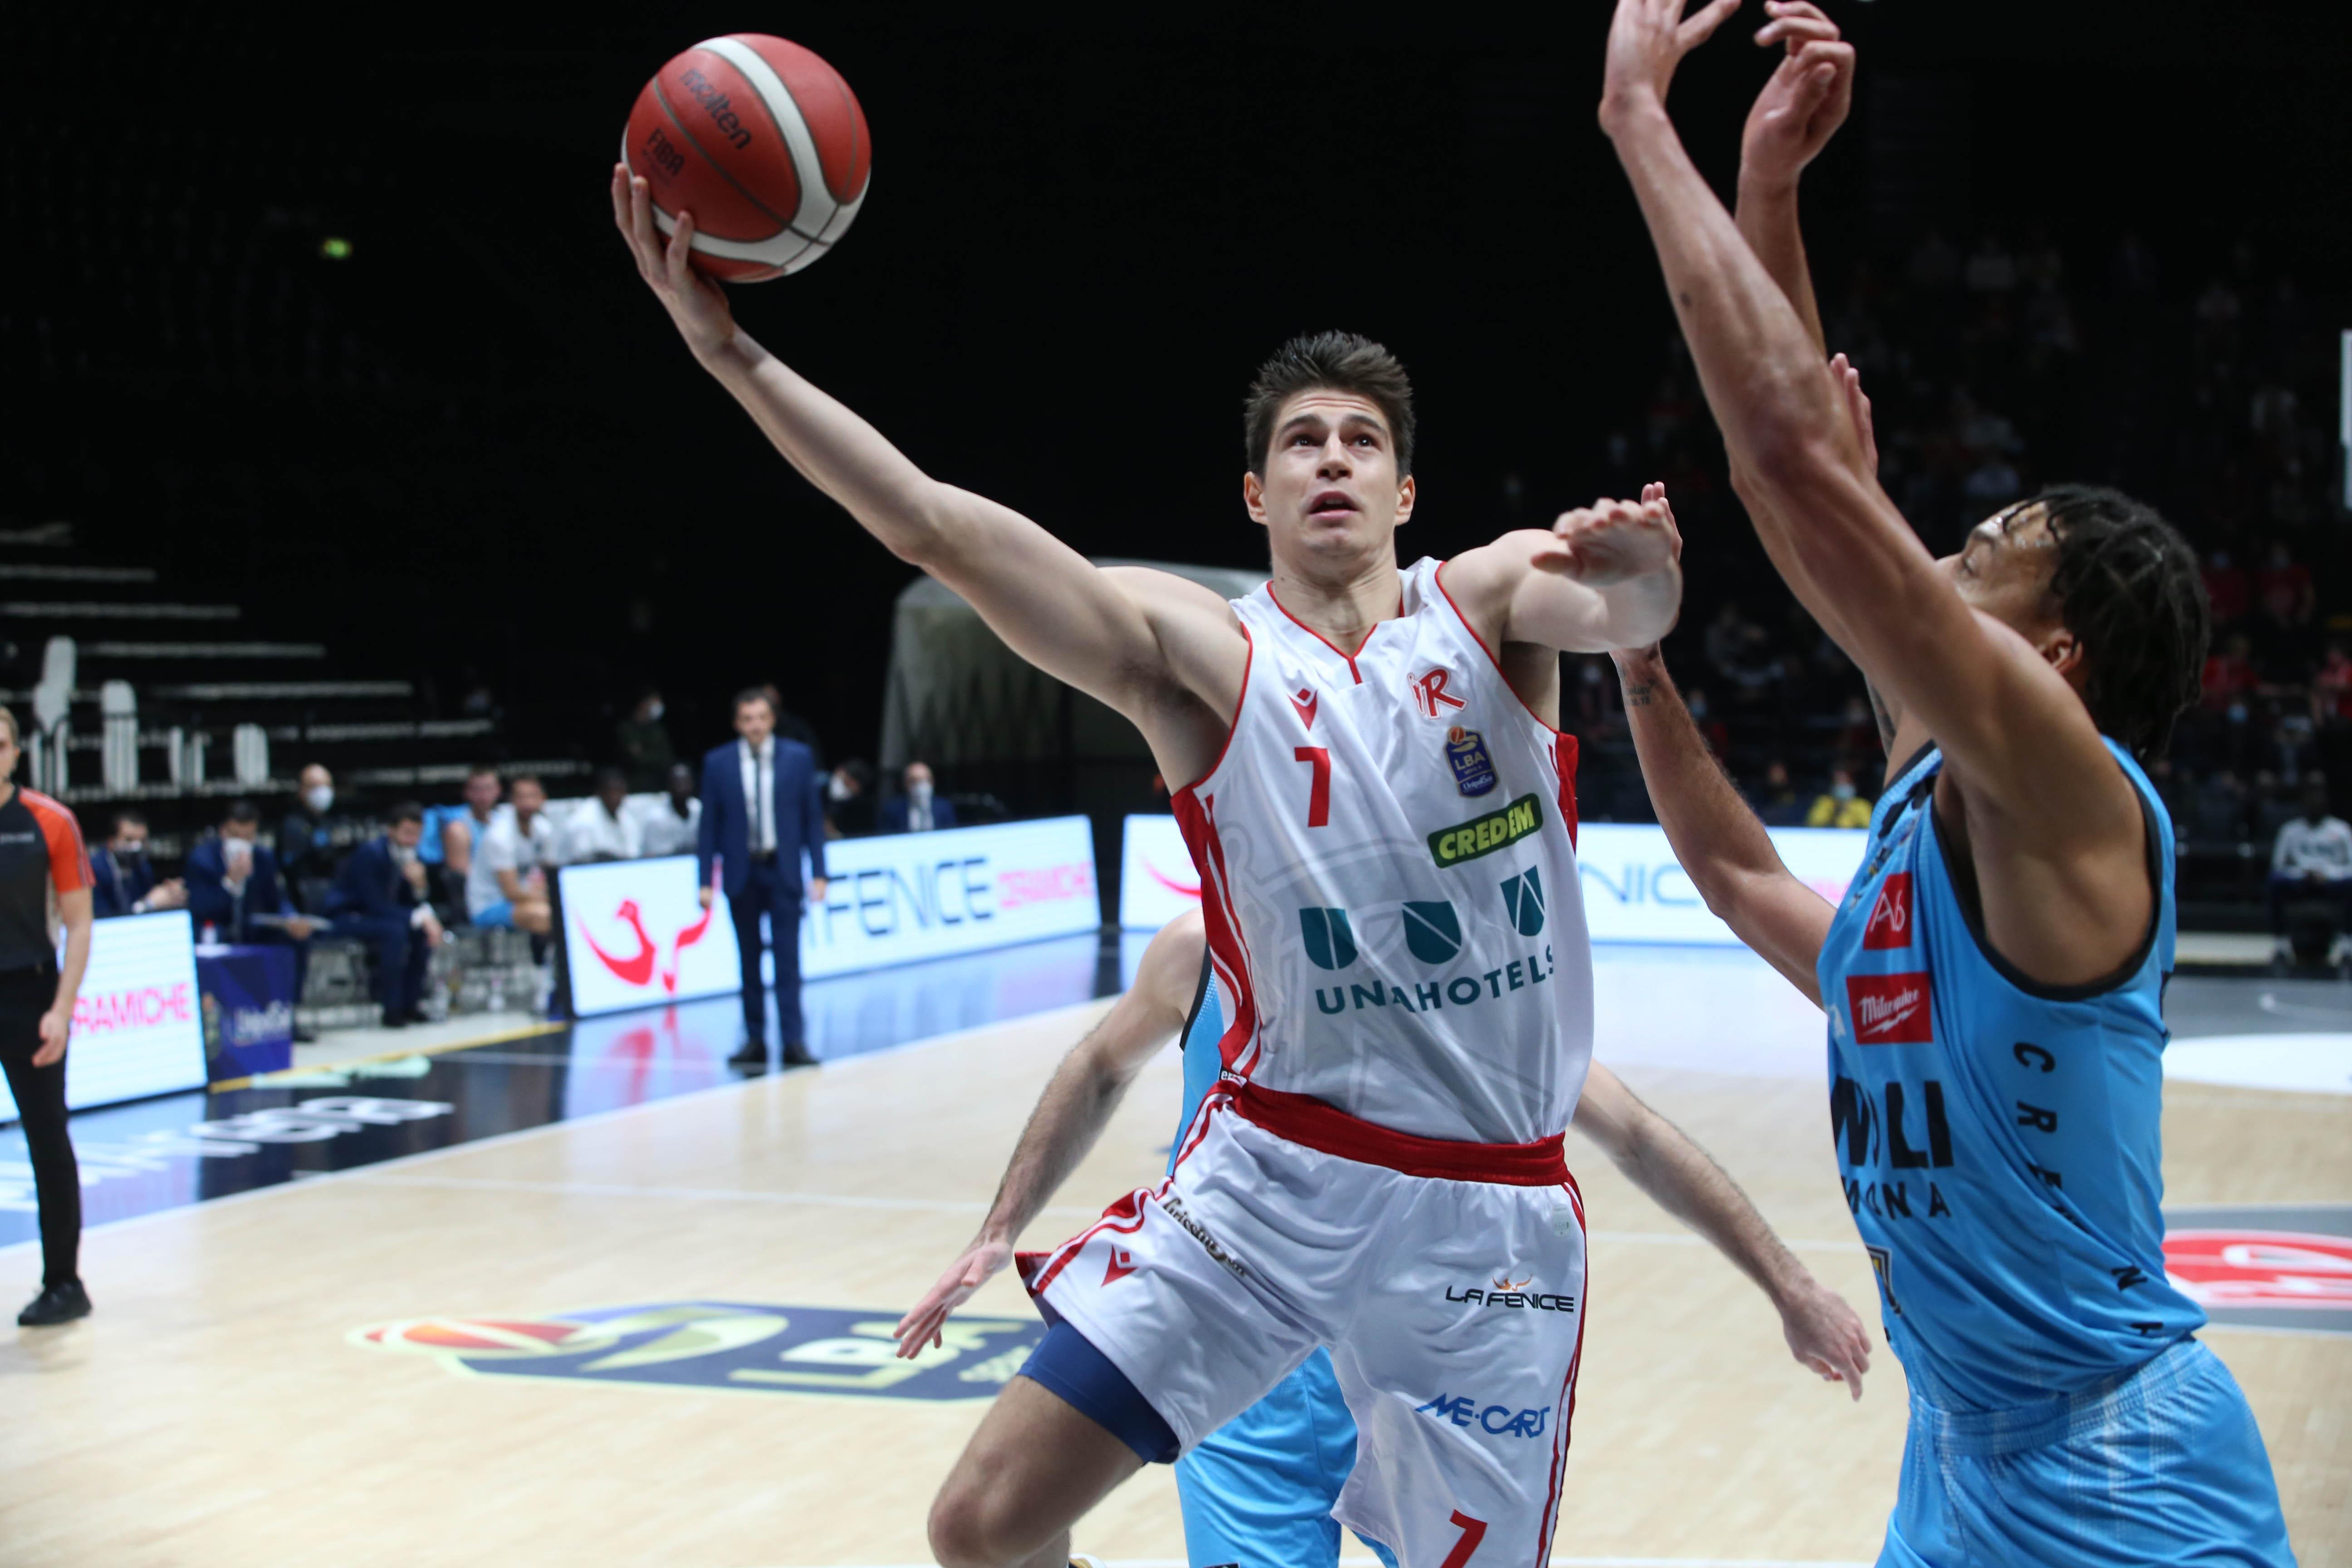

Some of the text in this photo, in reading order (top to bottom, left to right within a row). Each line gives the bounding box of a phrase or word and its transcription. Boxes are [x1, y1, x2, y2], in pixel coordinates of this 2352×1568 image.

[680, 68, 752, 151] molten
[646, 127, 685, 176] FIBA
[1294, 747, 1331, 828] 7
[1455, 751, 1485, 770] LBA
[1439, 800, 1535, 859] CREDEM
[825, 857, 994, 945] FENICE
[1315, 943, 1553, 1015] UNAHOTELS
[1445, 1285, 1574, 1313] LA FENICE
[1439, 1509, 1488, 1568] 7
